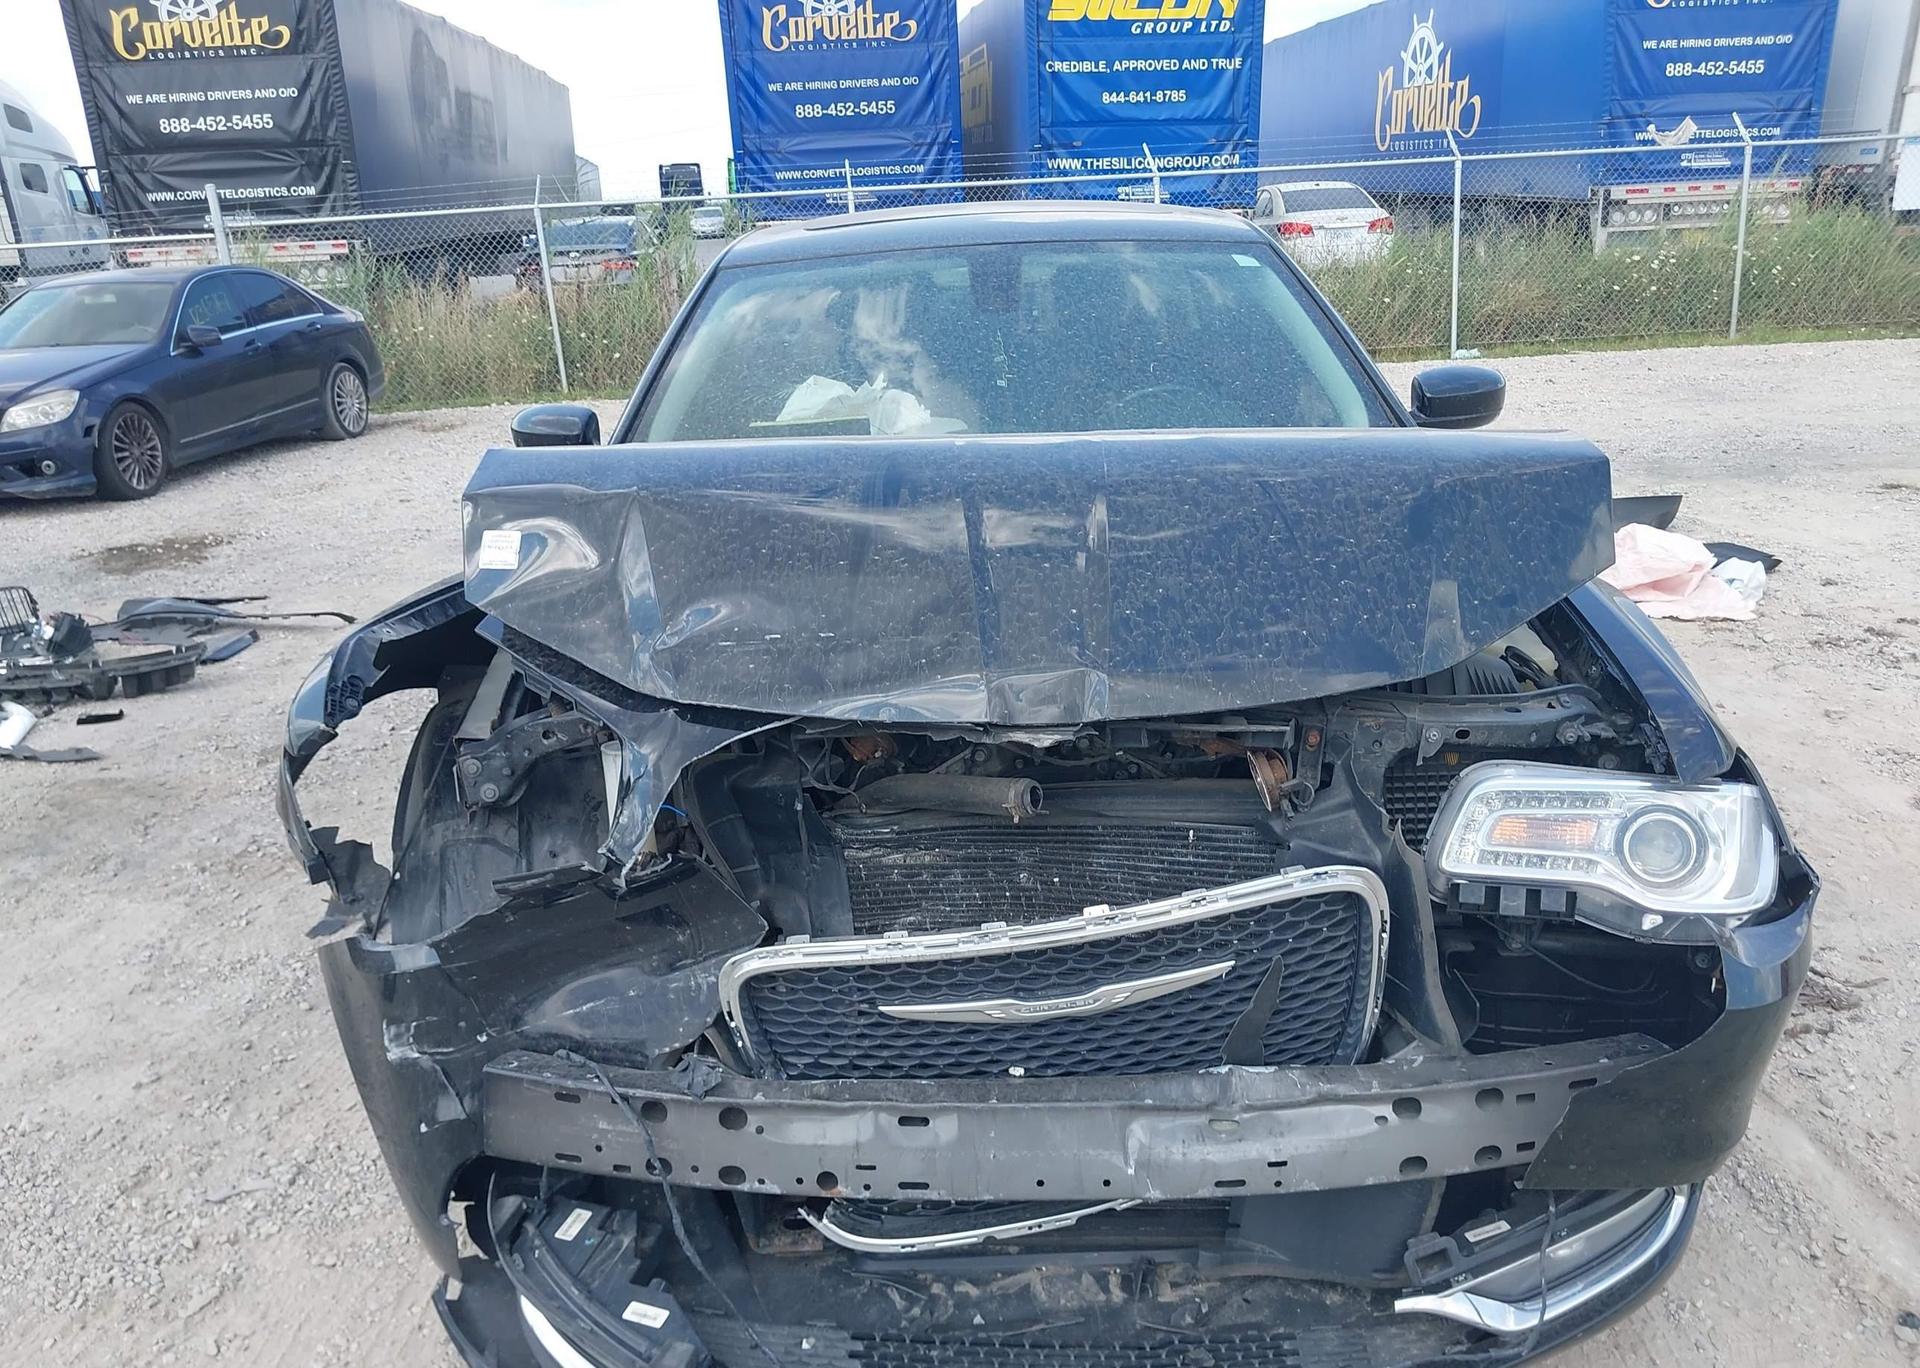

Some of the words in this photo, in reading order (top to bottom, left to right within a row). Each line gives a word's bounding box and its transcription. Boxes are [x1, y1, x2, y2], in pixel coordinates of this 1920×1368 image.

[109, 1, 291, 61] Corvette
[761, 0, 917, 51] Corvette
[1131, 21, 1193, 34] GROUP
[1200, 20, 1235, 33] LTD.
[791, 42, 857, 51] LOGISTICS
[866, 40, 892, 48] INC.
[1643, 40, 1658, 49] WE
[1659, 39, 1677, 49] ARE
[1679, 37, 1711, 48] HIRING
[1714, 36, 1752, 47] DRIVERS
[1754, 35, 1774, 46] AND
[1775, 34, 1792, 44] O/O
[148, 49, 224, 60] LOGISTICS
[233, 48, 264, 56] INC.
[1046, 60, 1110, 73] CREDIBLE,
[1113, 59, 1179, 71] APPROVED
[1182, 58, 1208, 70] AND
[1211, 57, 1243, 69] TRUE
[1666, 60, 1765, 77] 888-452-5455
[768, 83, 784, 92] WE
[785, 81, 803, 91] ARE
[805, 80, 838, 90] HIRING
[839, 78, 879, 89] DRIVERS
[881, 77, 901, 87] AND
[902, 76, 919, 86] O/O
[126, 94, 143, 105] WE
[145, 92, 167, 104] ARE
[168, 90, 206, 103] HIRING
[207, 89, 252, 101] DRIVERS
[254, 88, 277, 99] AND
[278, 87, 298, 98] O/O
[1102, 90, 1187, 104] 844-641-8785
[795, 100, 895, 118] 888-452-5455
[159, 114, 273, 133] 888-452-5455
[1390, 138, 1434, 151] LOGISTICS
[1047, 154, 1239, 170] WWW.THESILICONGROUP.COM
[776, 164, 924, 180] WWW.CORVETTELOGISTICS.COM
[146, 185, 316, 202] WWW.CORVTELOGISTICS.COM
